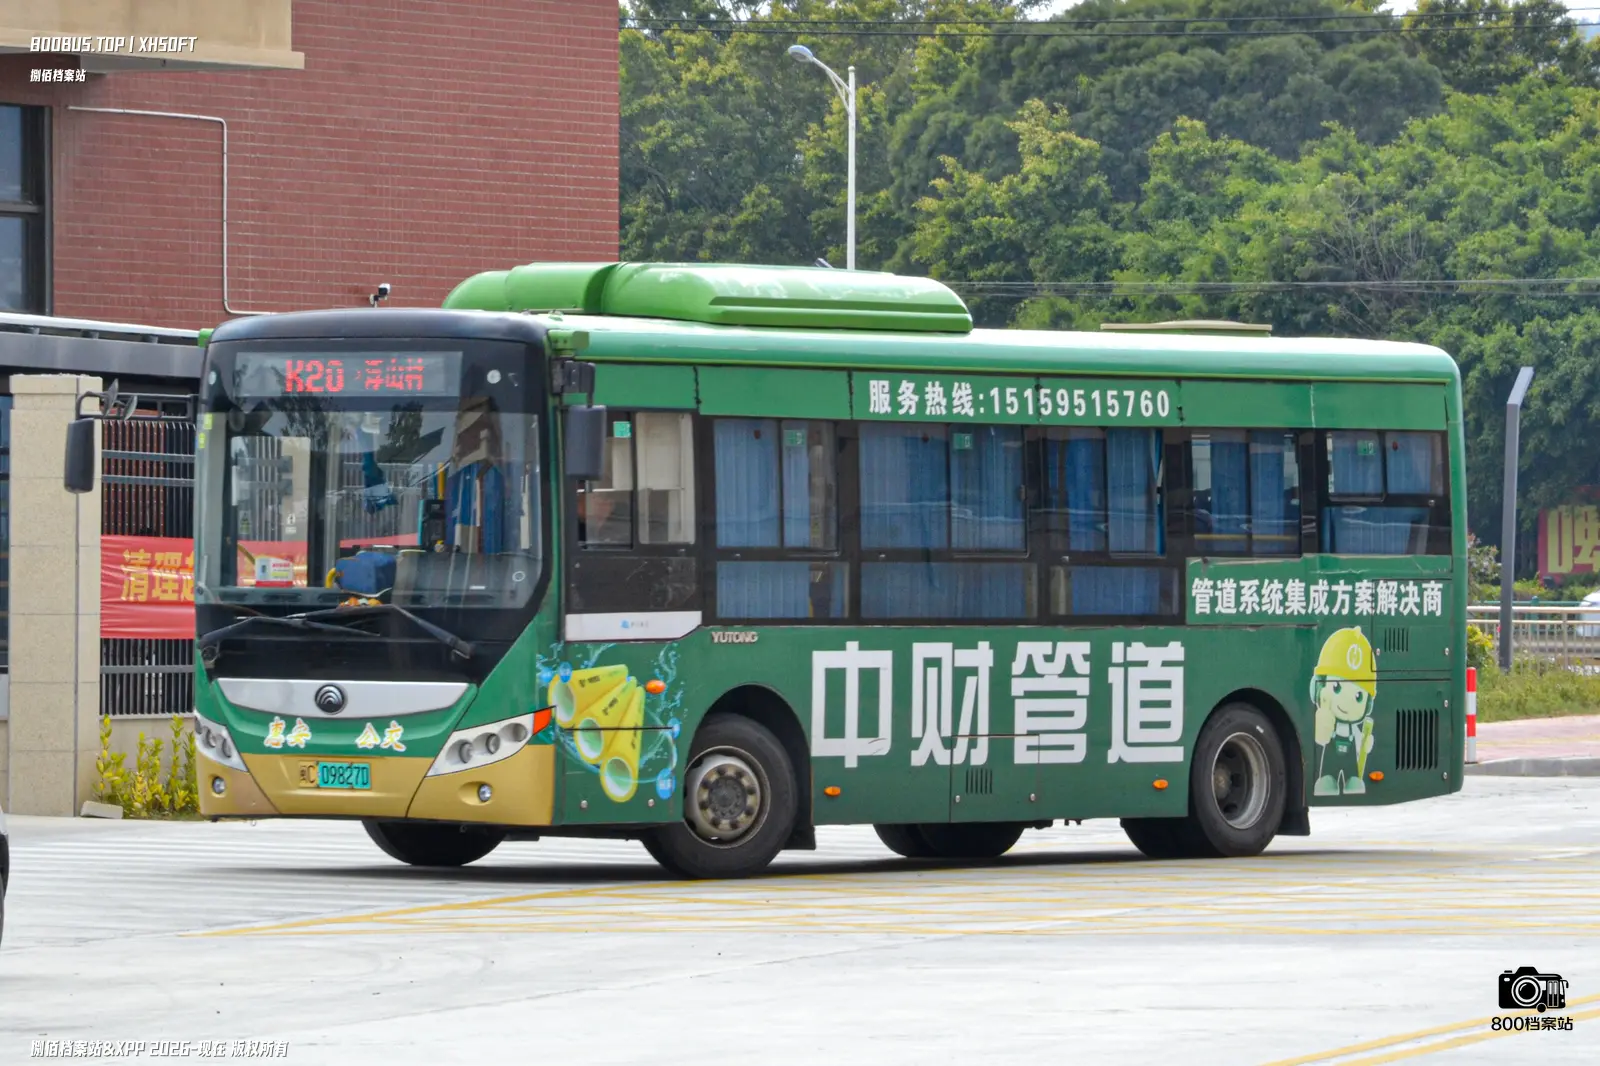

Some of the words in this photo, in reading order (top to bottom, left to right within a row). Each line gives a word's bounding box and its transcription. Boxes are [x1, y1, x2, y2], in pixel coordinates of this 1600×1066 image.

[286, 359, 344, 392] K20
[869, 379, 1170, 417] 服务热线:15159515760
[1191, 578, 1443, 617] 管道系统集成方案解决商
[711, 631, 758, 643] YUTONG
[811, 641, 1185, 768] 中财管道
[264, 716, 312, 749] 惠安
[355, 720, 406, 752] 公交
